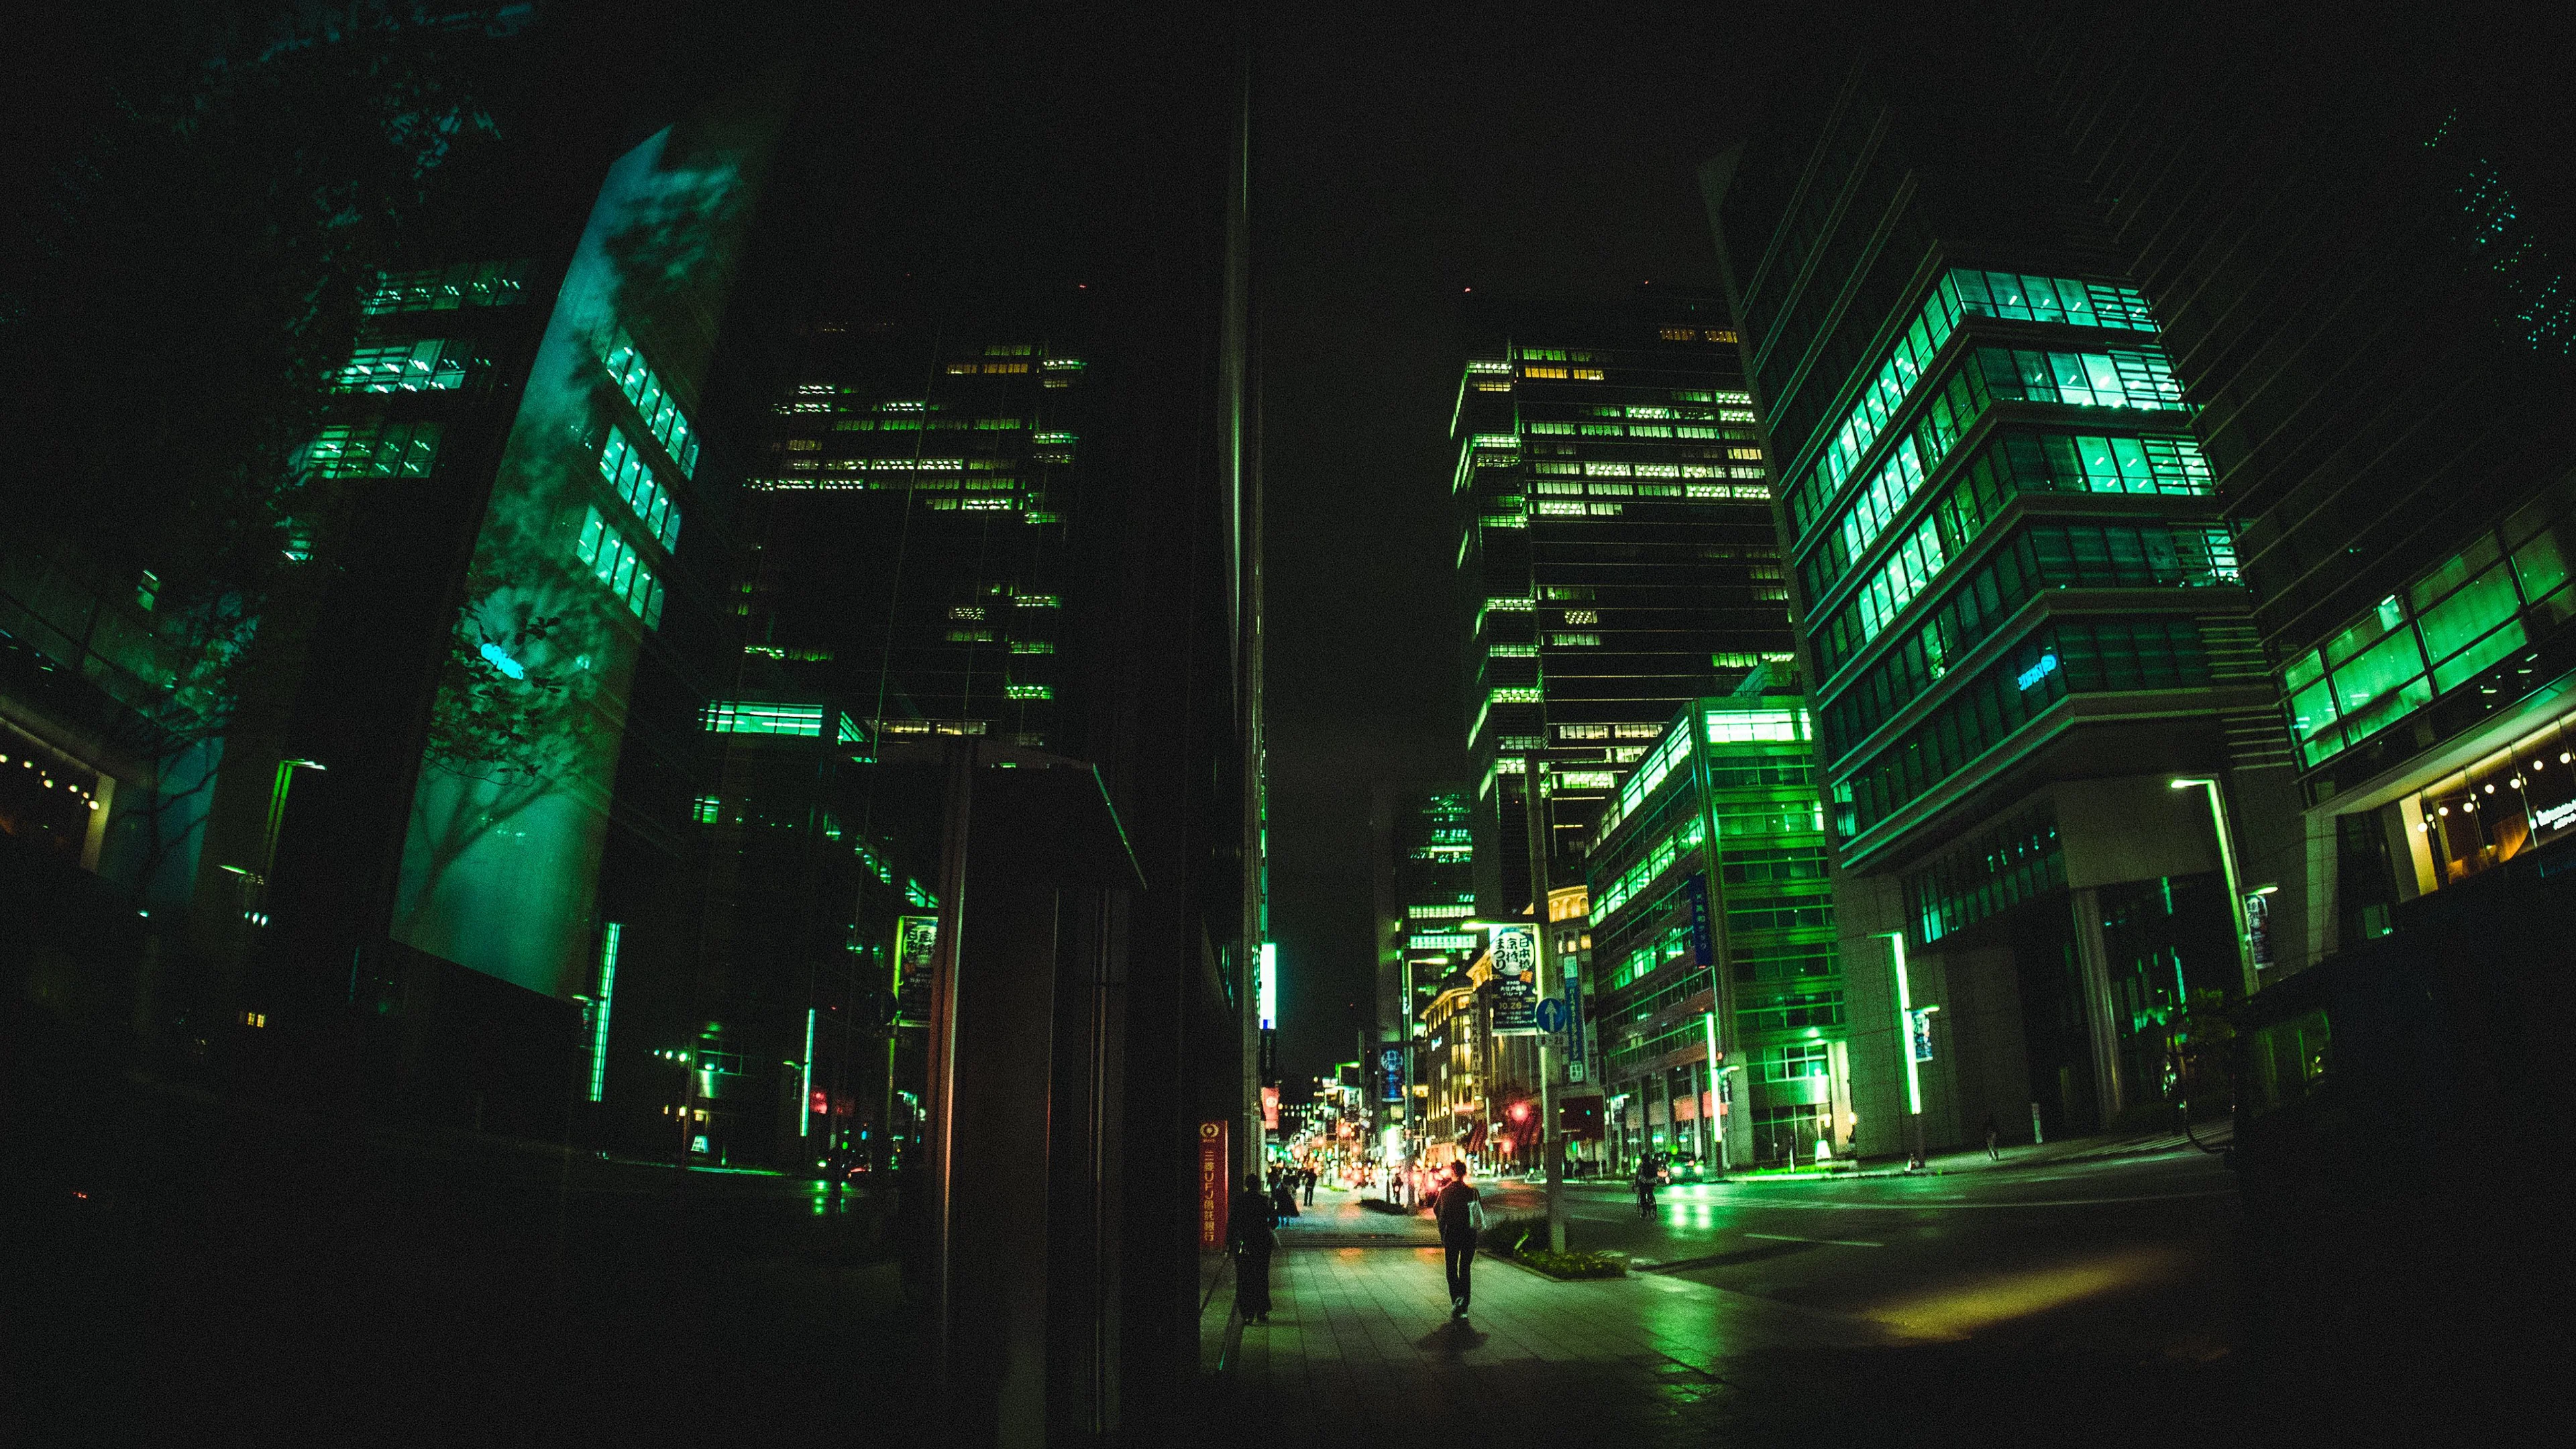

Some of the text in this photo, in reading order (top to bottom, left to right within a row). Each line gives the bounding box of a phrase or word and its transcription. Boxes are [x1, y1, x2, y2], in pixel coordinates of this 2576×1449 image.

[1493, 938, 1506, 971] まつり
[1506, 938, 1519, 963] 京橋
[1519, 938, 1531, 969] 日本橋
[1204, 1150, 1215, 1242] 三菱UFJ信託銀行
